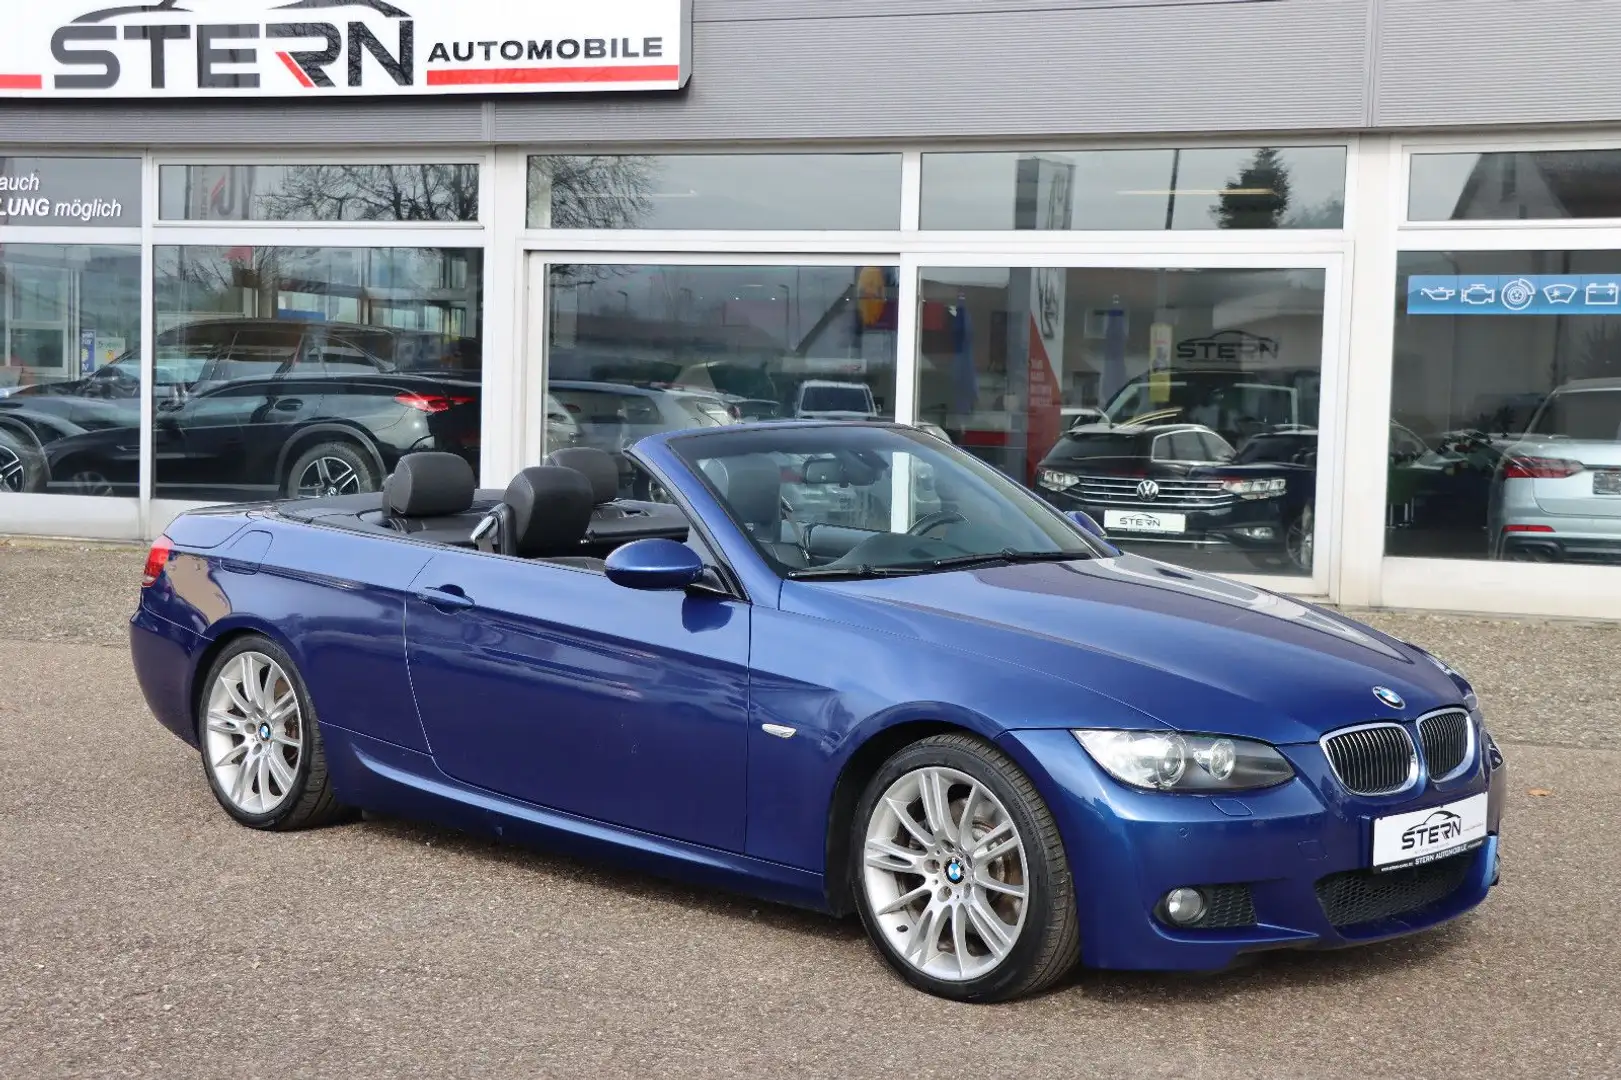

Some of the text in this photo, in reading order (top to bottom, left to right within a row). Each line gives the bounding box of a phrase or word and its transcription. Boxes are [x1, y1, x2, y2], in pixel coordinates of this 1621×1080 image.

[50, 20, 663, 90] STERN AUTOMOBILE
[0, 172, 40, 191] auch
[55, 198, 122, 222] möglich
[1176, 342, 1279, 360] STERN
[1119, 517, 1161, 527] STERN
[1401, 819, 1461, 850] STERN
